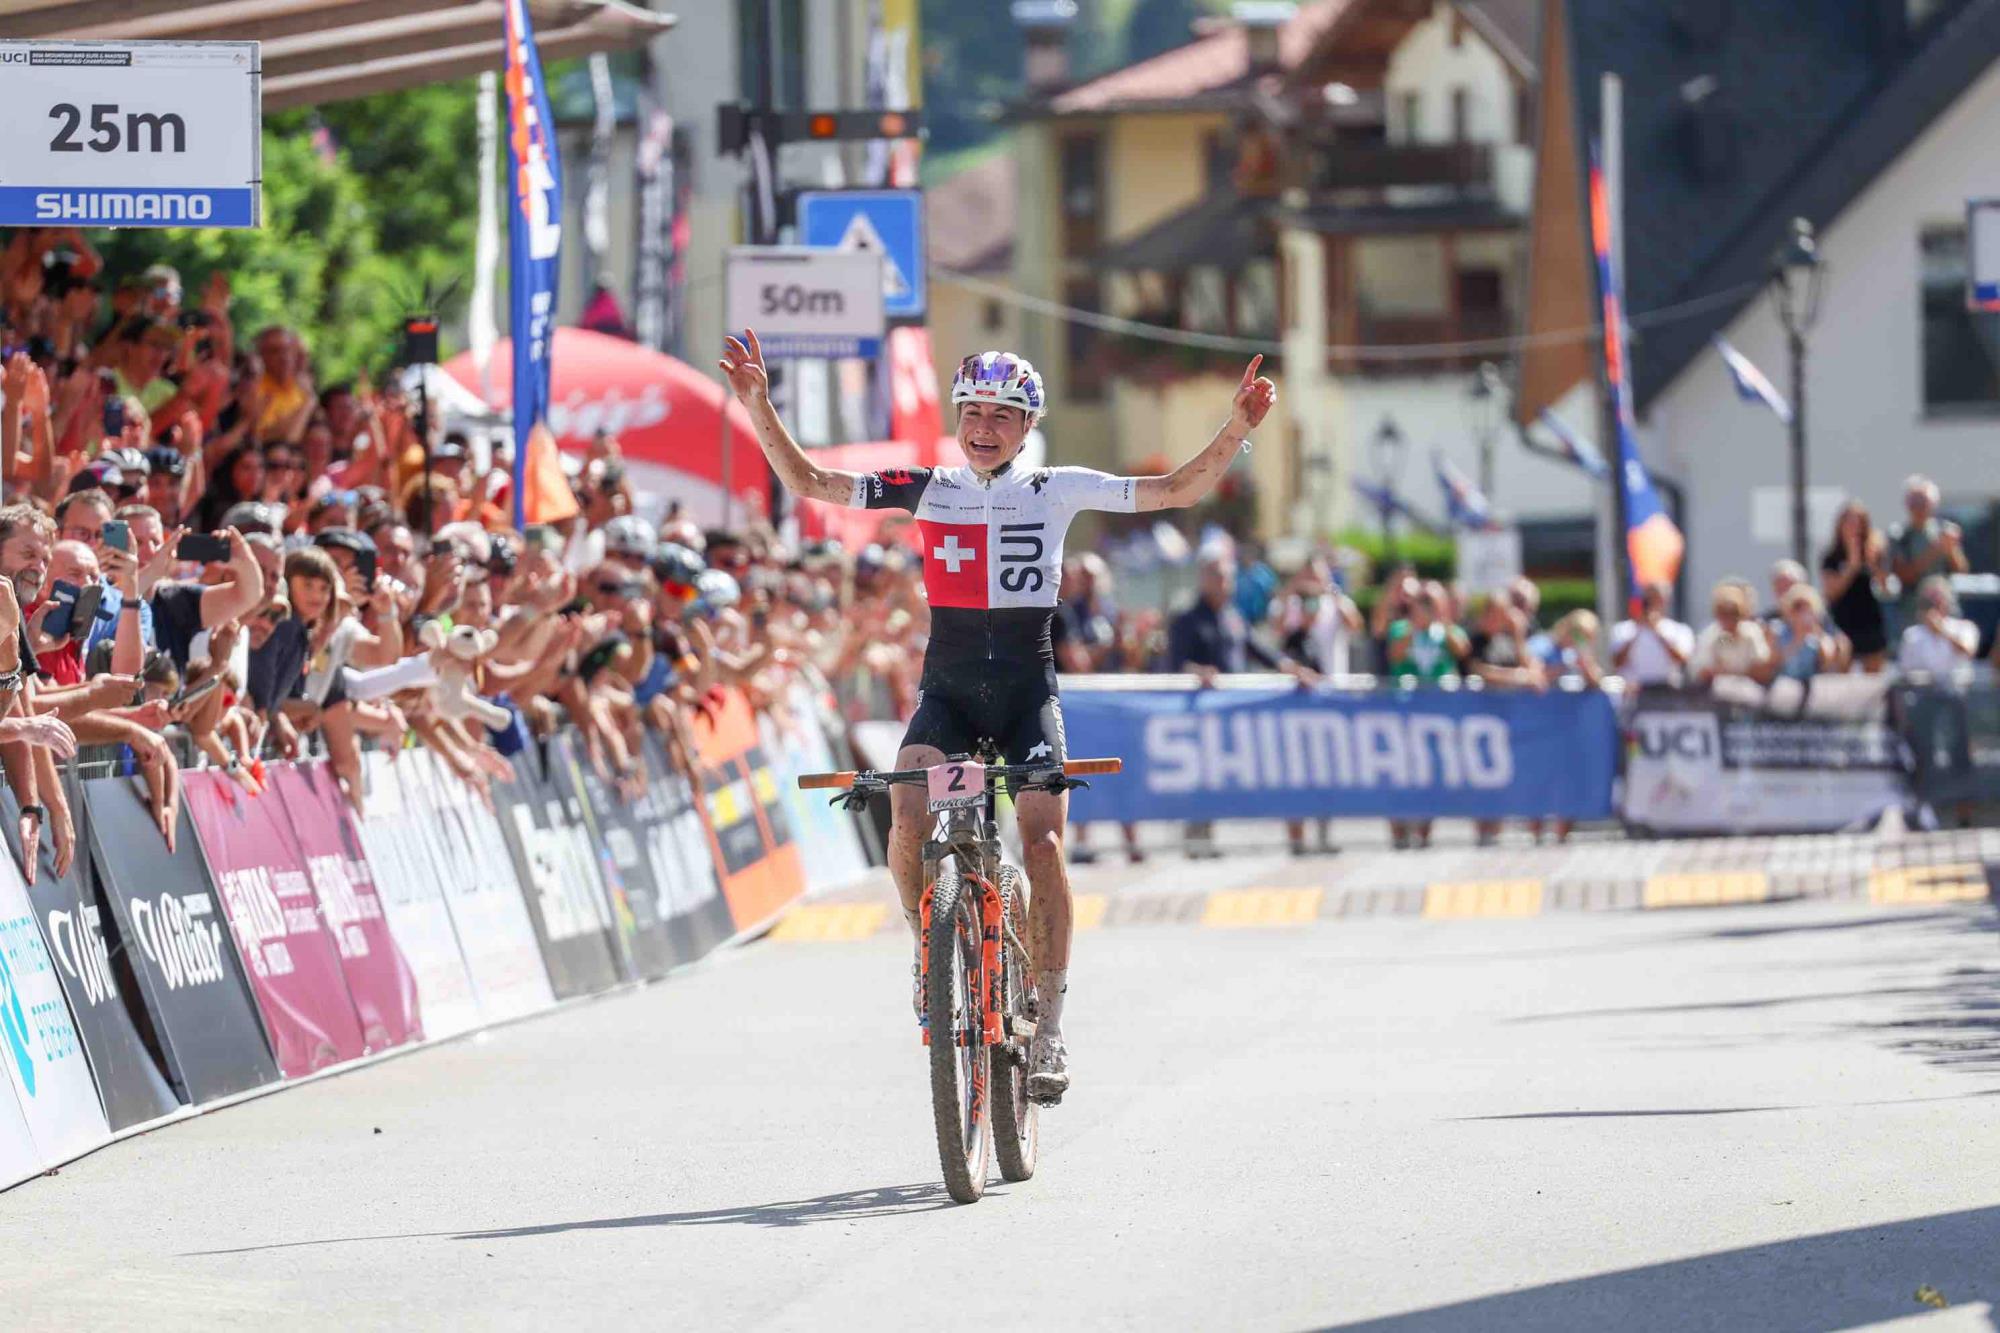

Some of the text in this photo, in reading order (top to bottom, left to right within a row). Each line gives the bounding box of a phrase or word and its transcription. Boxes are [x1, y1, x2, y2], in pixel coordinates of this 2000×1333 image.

[3, 53, 27, 63] UCI
[49, 103, 186, 152] 25m
[36, 193, 212, 220] SHIMANO
[762, 284, 844, 315] 50m
[1000, 523, 1045, 592] SUI
[1145, 711, 1513, 793] SHIMANO
[1640, 725, 1712, 759] UCI
[947, 766, 966, 792] 2
